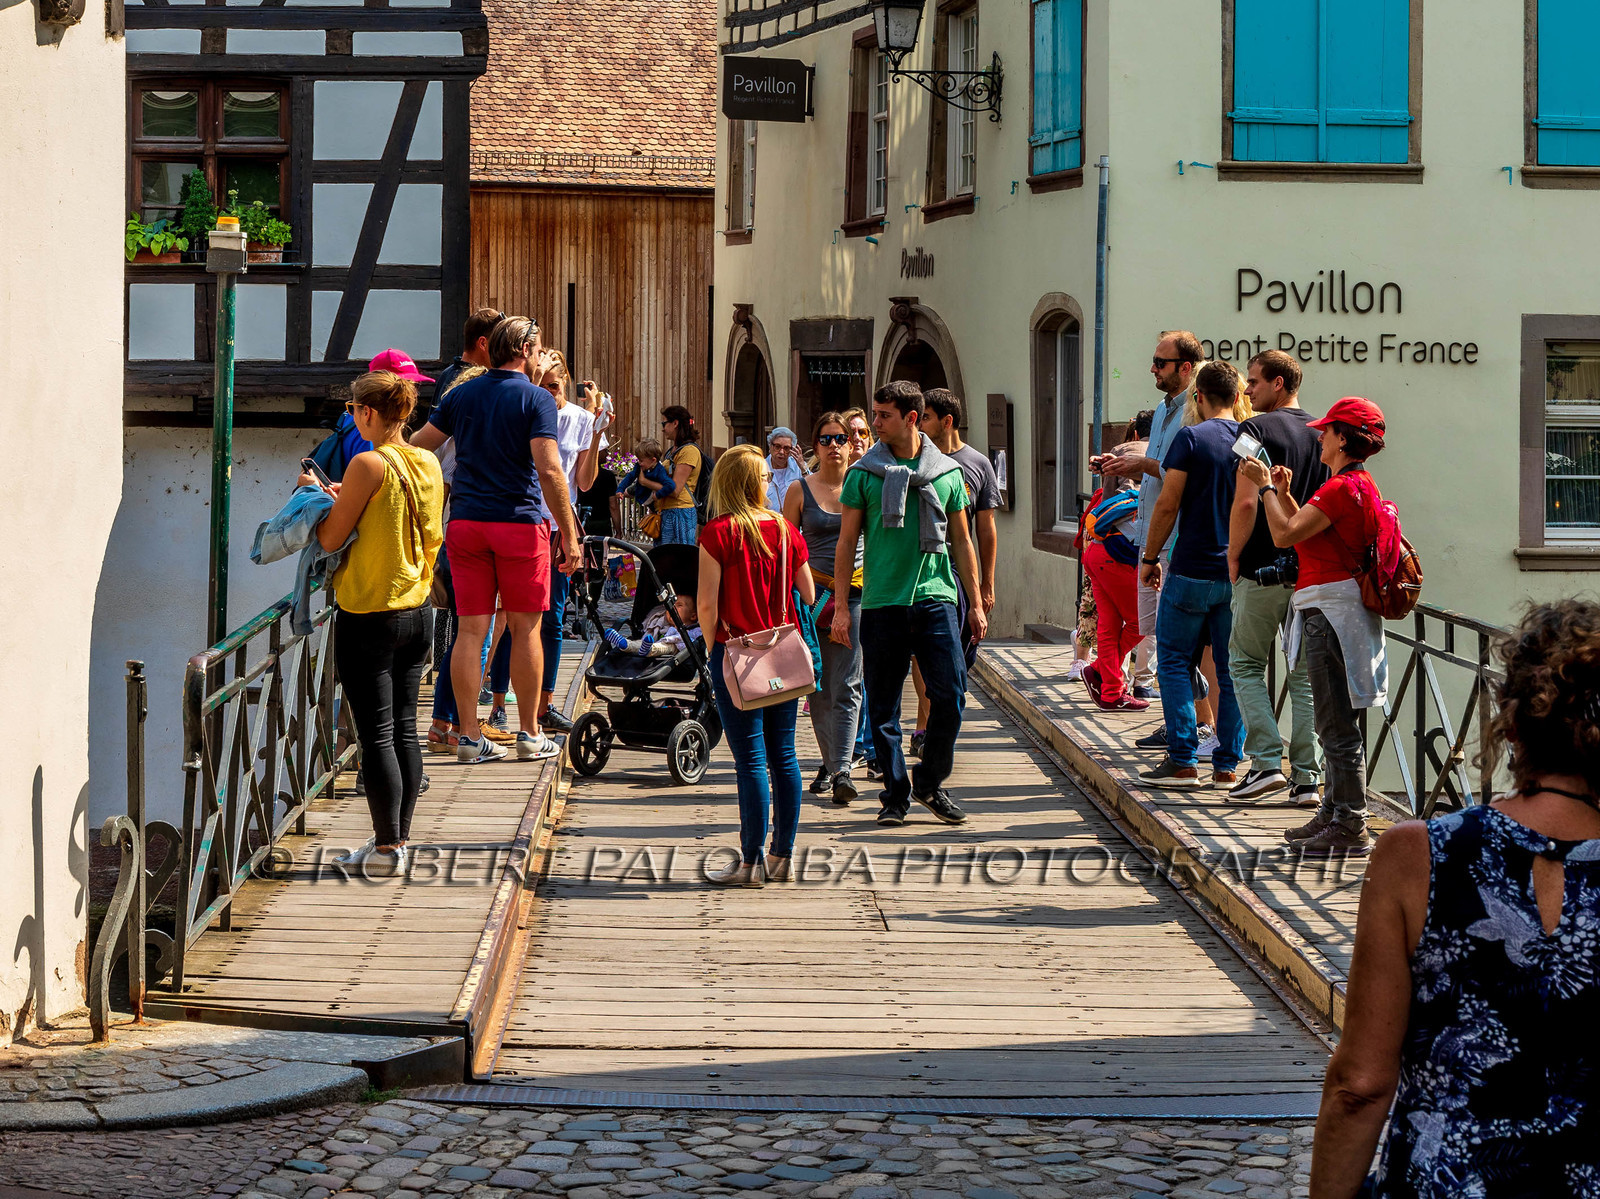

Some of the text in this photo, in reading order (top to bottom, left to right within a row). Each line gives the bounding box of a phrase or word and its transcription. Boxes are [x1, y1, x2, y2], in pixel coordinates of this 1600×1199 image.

[733, 74, 796, 95] Pavillon
[900, 246, 934, 279] Pavillon
[1237, 268, 1402, 314] Pavillon
[1200, 332, 1479, 364] gent Petite France
